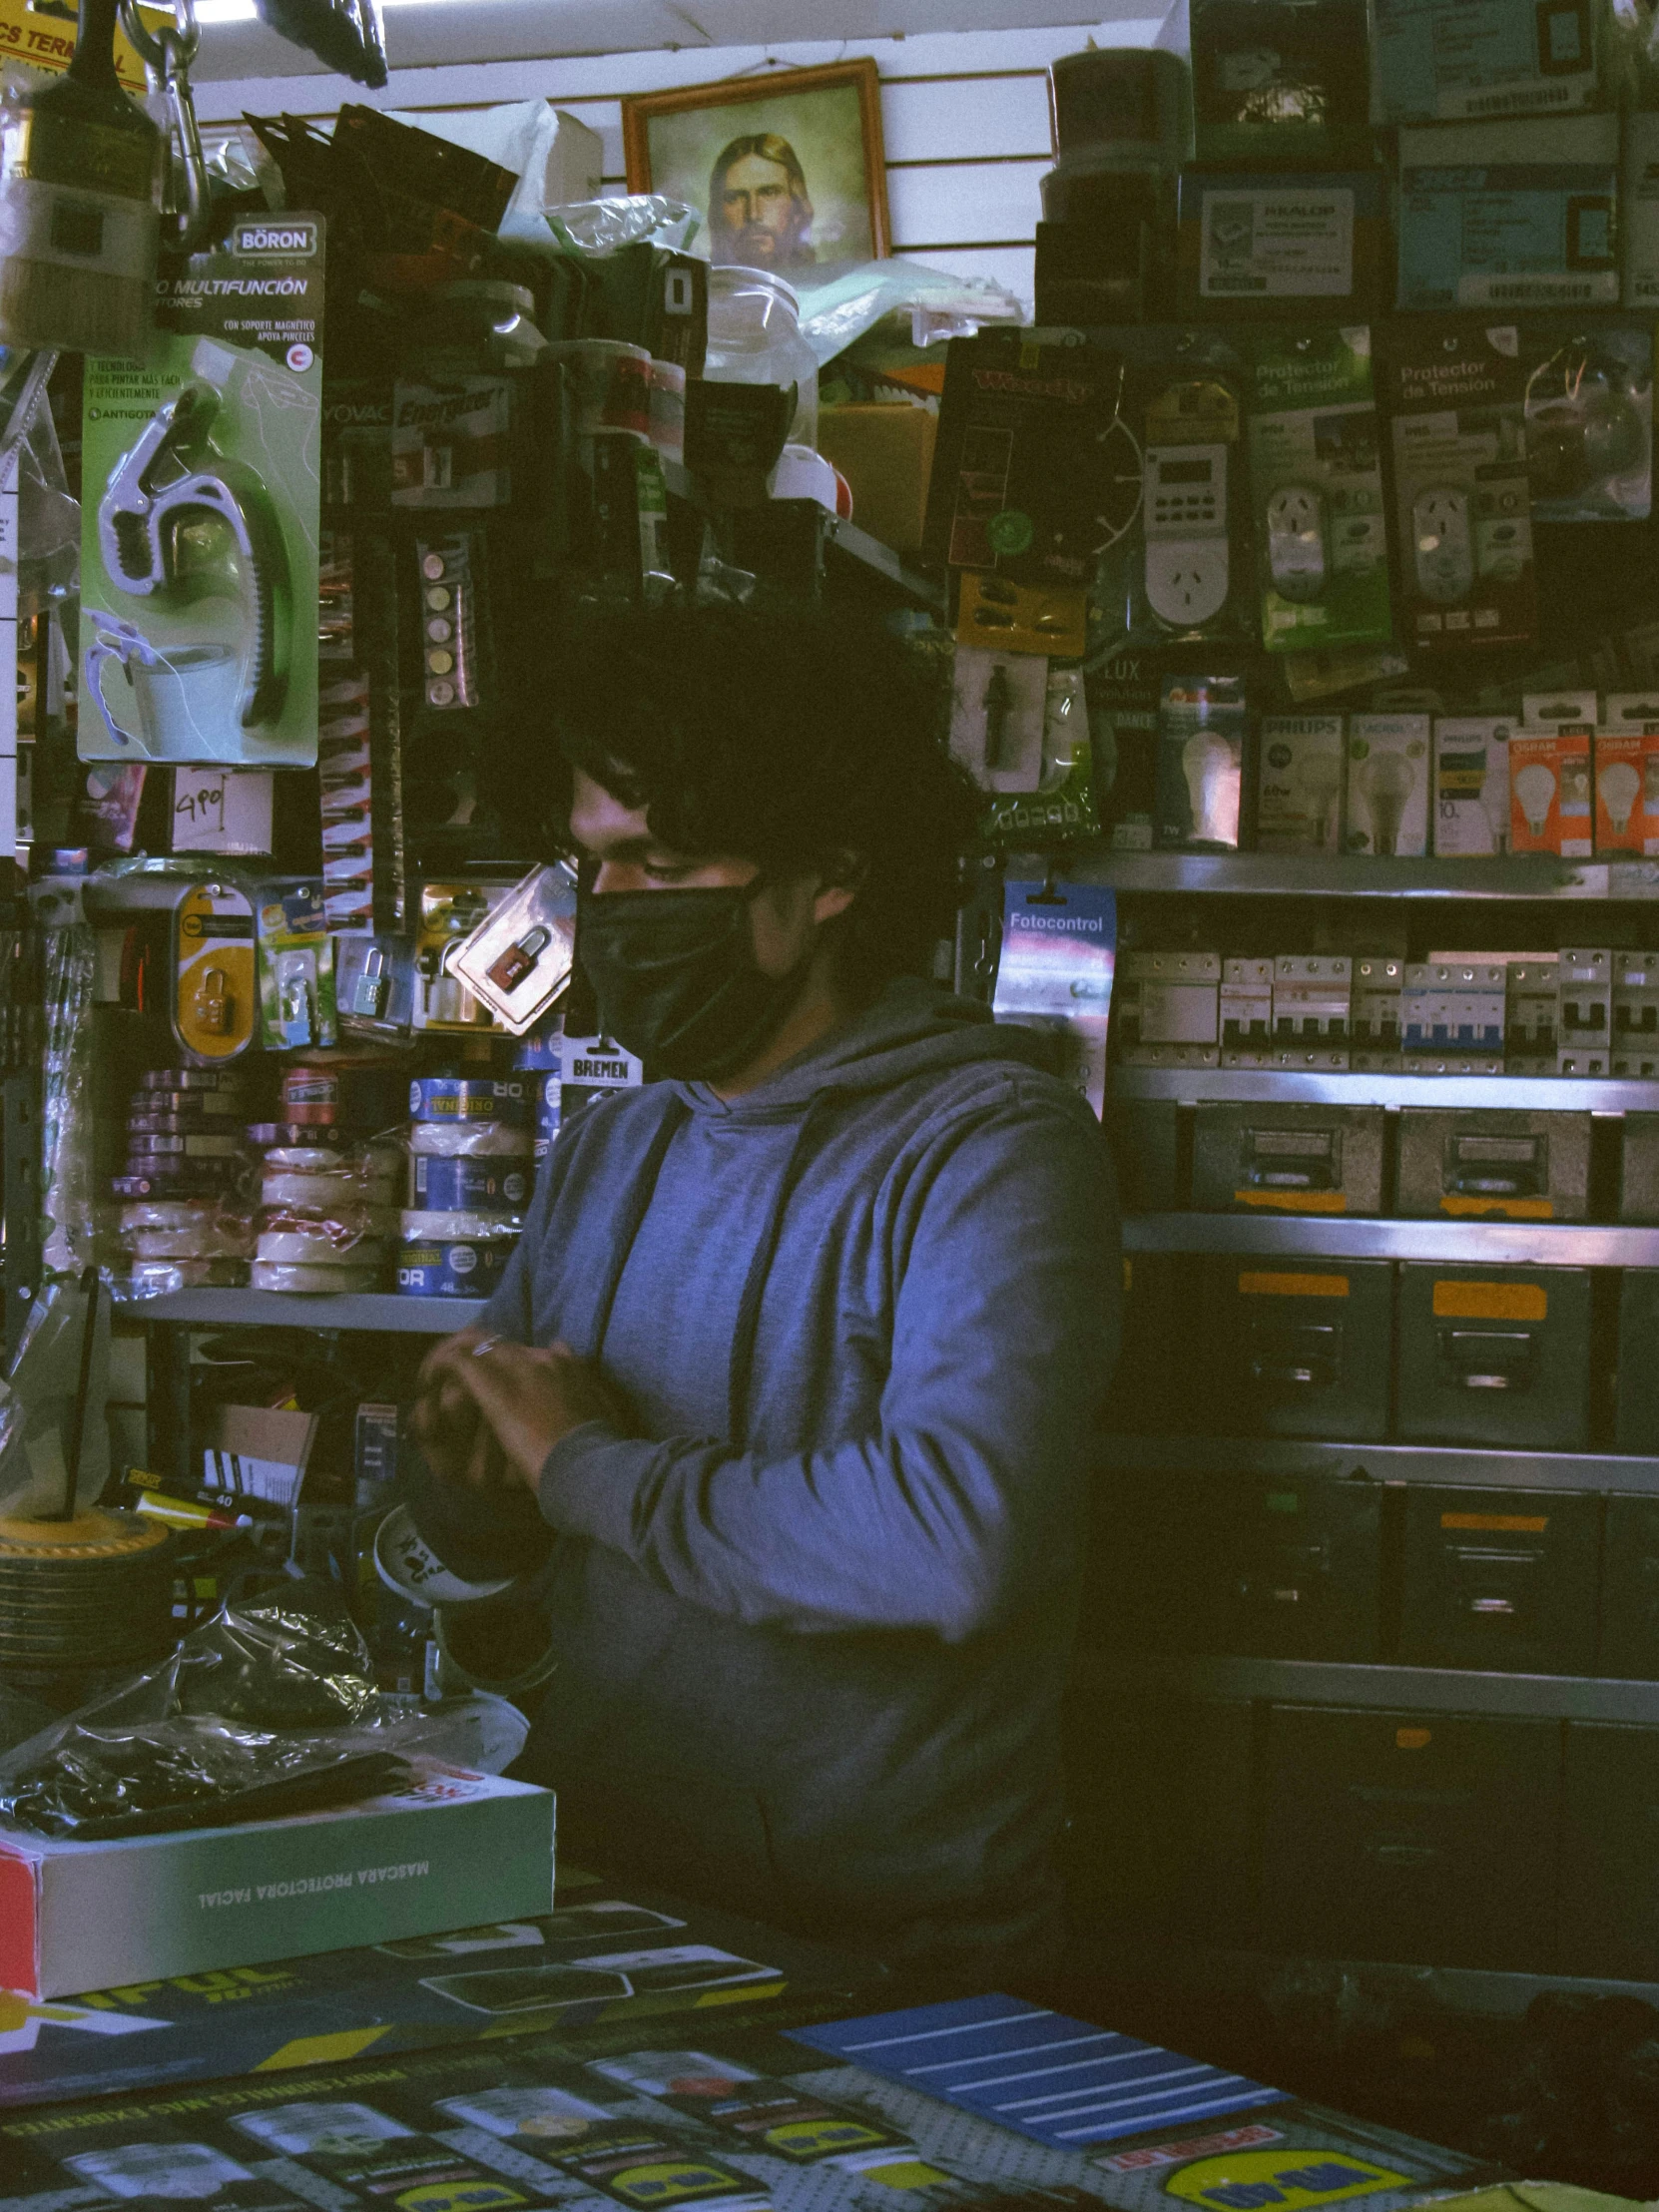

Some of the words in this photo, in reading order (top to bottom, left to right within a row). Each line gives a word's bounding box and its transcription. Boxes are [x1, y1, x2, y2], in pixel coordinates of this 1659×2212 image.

[175, 276, 307, 295] MULTIFUNCIÓN
[224, 320, 239, 330] CON
[242, 320, 273, 330] SOPORTE
[1400, 361, 1486, 383] Protector
[1402, 385, 1424, 399] de
[1266, 719, 1338, 735] PHILIPS
[1010, 912, 1104, 932] Fotocontrol
[573, 1059, 628, 1079] BREMEN
[432, 1099, 494, 1112] ORIGINAL
[216, 1494, 233, 1508] 40
[256, 1873, 352, 1902] PROTECTORA
[199, 1887, 252, 1910] FACIAL
